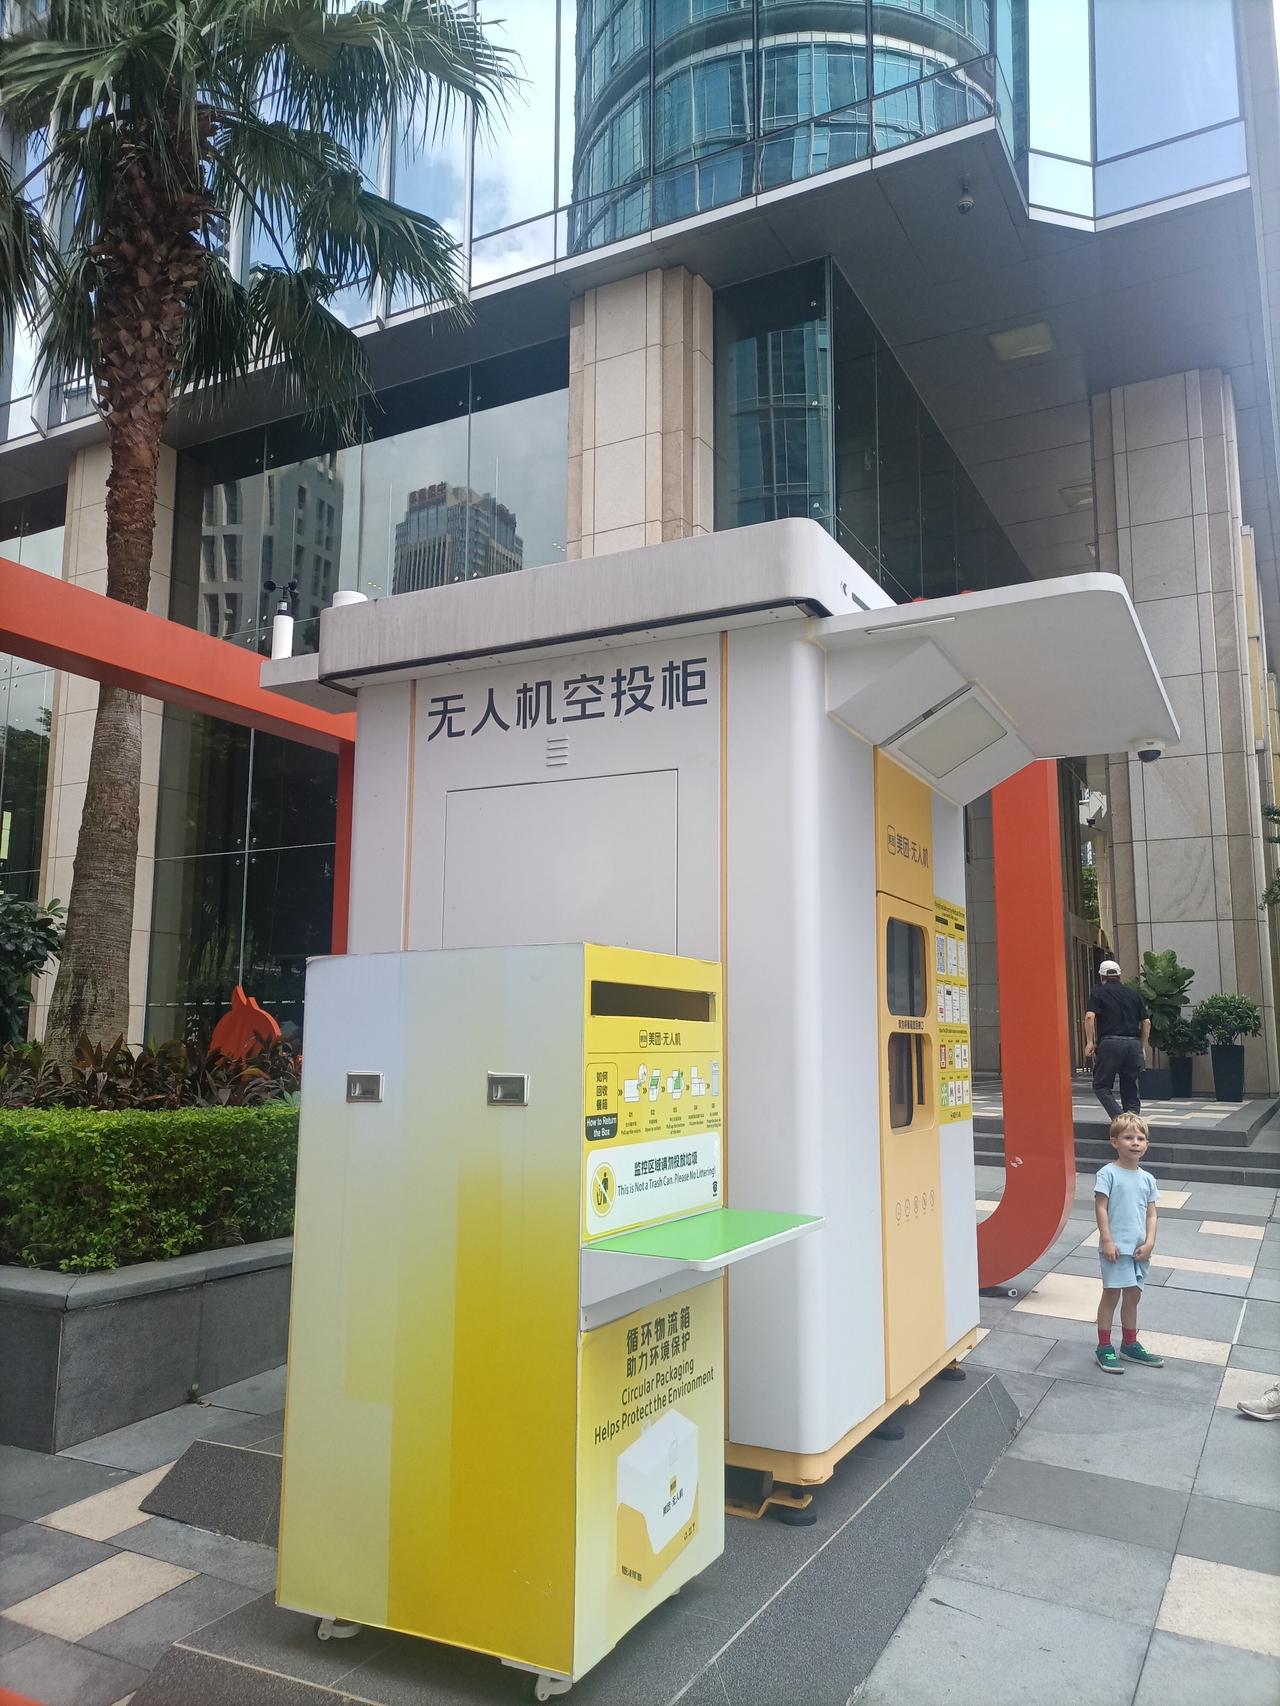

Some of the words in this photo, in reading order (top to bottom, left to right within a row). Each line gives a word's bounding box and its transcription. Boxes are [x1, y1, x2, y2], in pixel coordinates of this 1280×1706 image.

[428, 657, 708, 742] 无人机空投柜
[596, 1071, 608, 1083] 如何
[596, 1085, 608, 1097] 回收
[586, 1118, 597, 1127] How
[597, 1117, 603, 1126] to
[602, 1115, 617, 1125] Return
[593, 1128, 601, 1138] the
[601, 1127, 610, 1137] Box
[634, 1151, 698, 1177] 监控区域请勿投放垃圾
[617, 1183, 629, 1196] This
[629, 1182, 635, 1194] is
[634, 1179, 645, 1192] Not
[645, 1181, 649, 1191] a
[649, 1176, 663, 1191] Trash
[662, 1175, 674, 1188] Can.
[674, 1172, 690, 1184] Please
[689, 1170, 697, 1182] No
[696, 1165, 717, 1179] Littering!
[626, 1305, 691, 1355] 循环物流箱
[626, 1331, 691, 1378] 助力环境保护
[621, 1377, 655, 1406] Circular
[655, 1358, 695, 1389] Packaging
[594, 1418, 620, 1445] Helps
[621, 1399, 653, 1431] Protect
[653, 1394, 667, 1411] the
[668, 1366, 715, 1404] Environment
